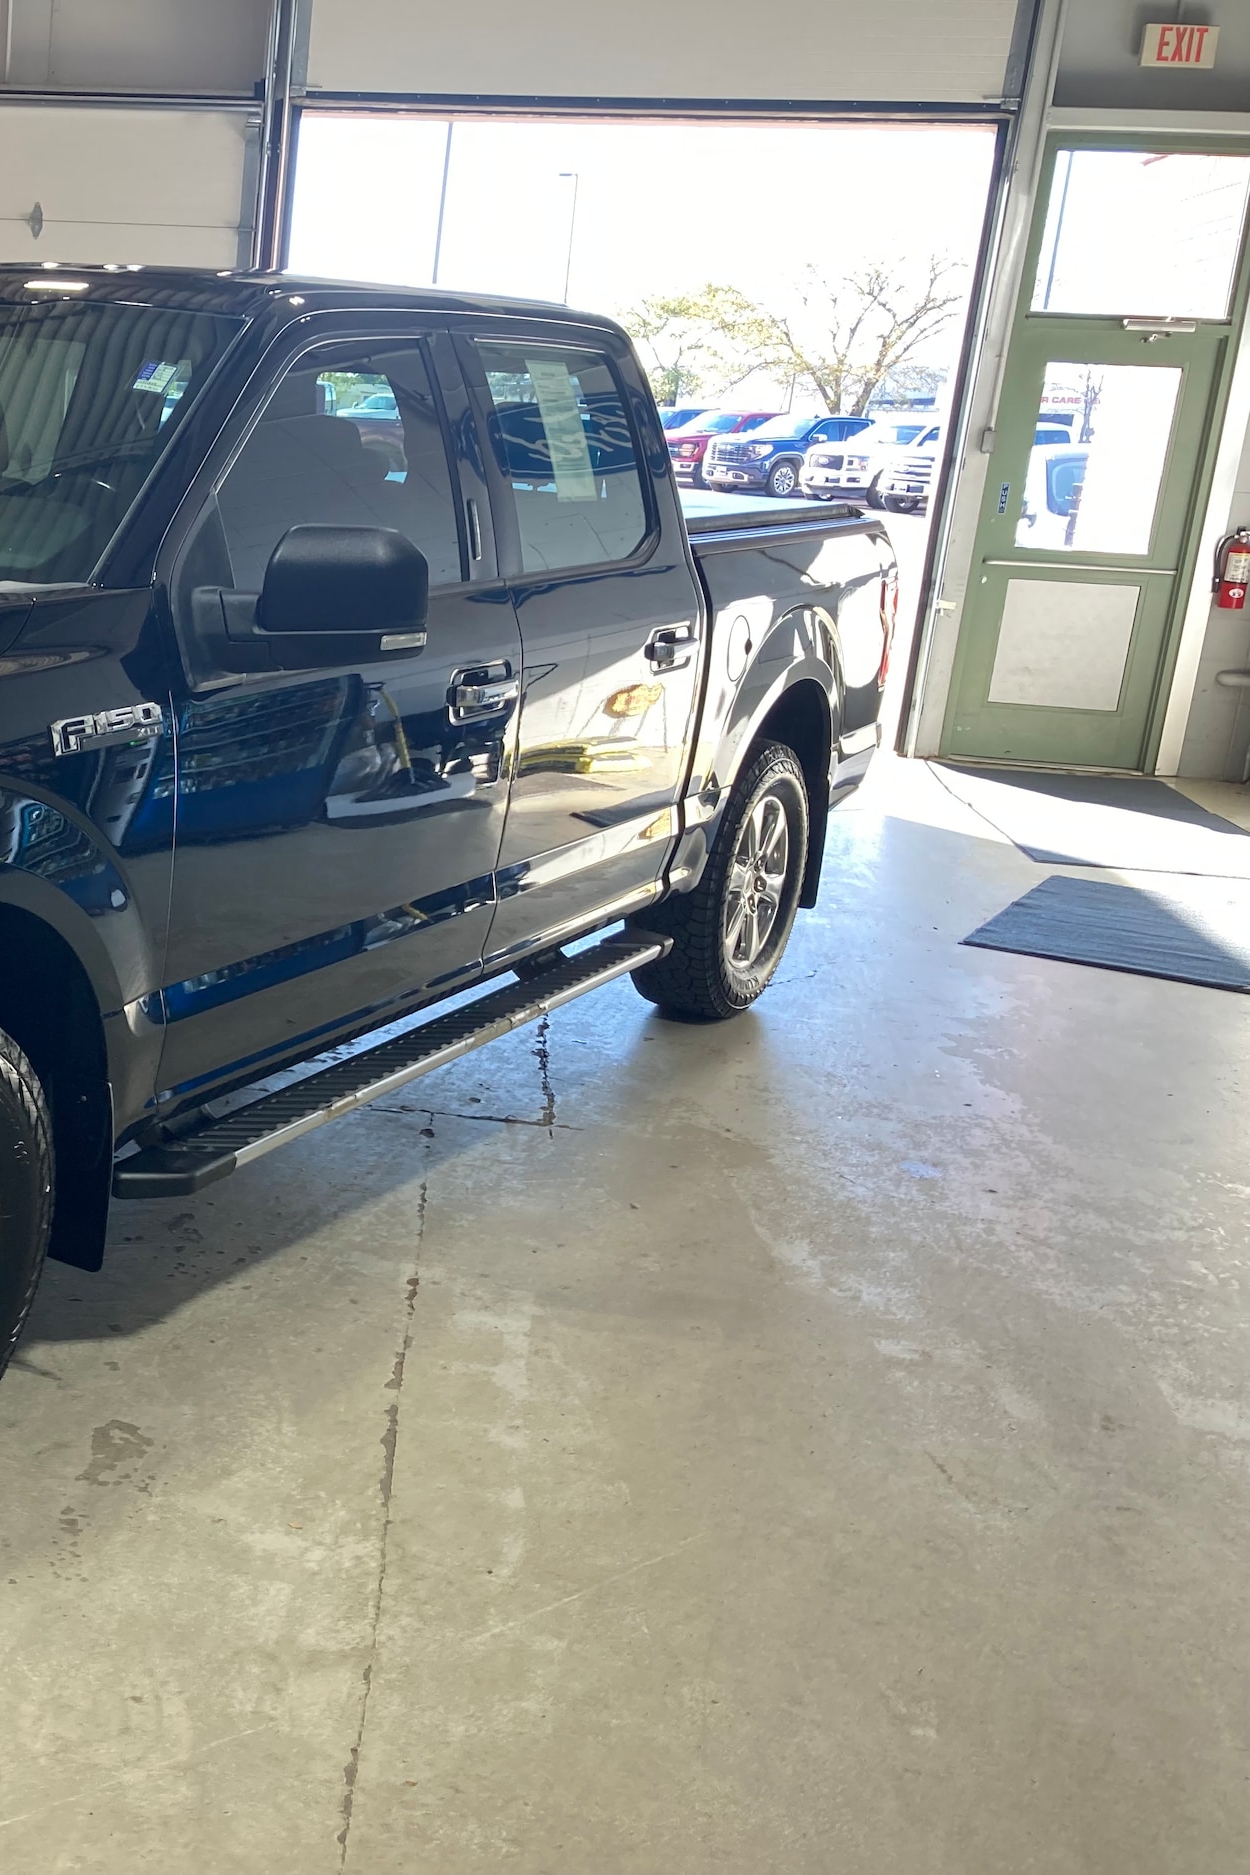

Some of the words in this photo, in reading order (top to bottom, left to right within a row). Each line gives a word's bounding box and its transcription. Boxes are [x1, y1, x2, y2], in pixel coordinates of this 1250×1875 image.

[1156, 26, 1209, 62] EXIT
[1052, 396, 1082, 404] CARE
[137, 726, 159, 737] XLT
